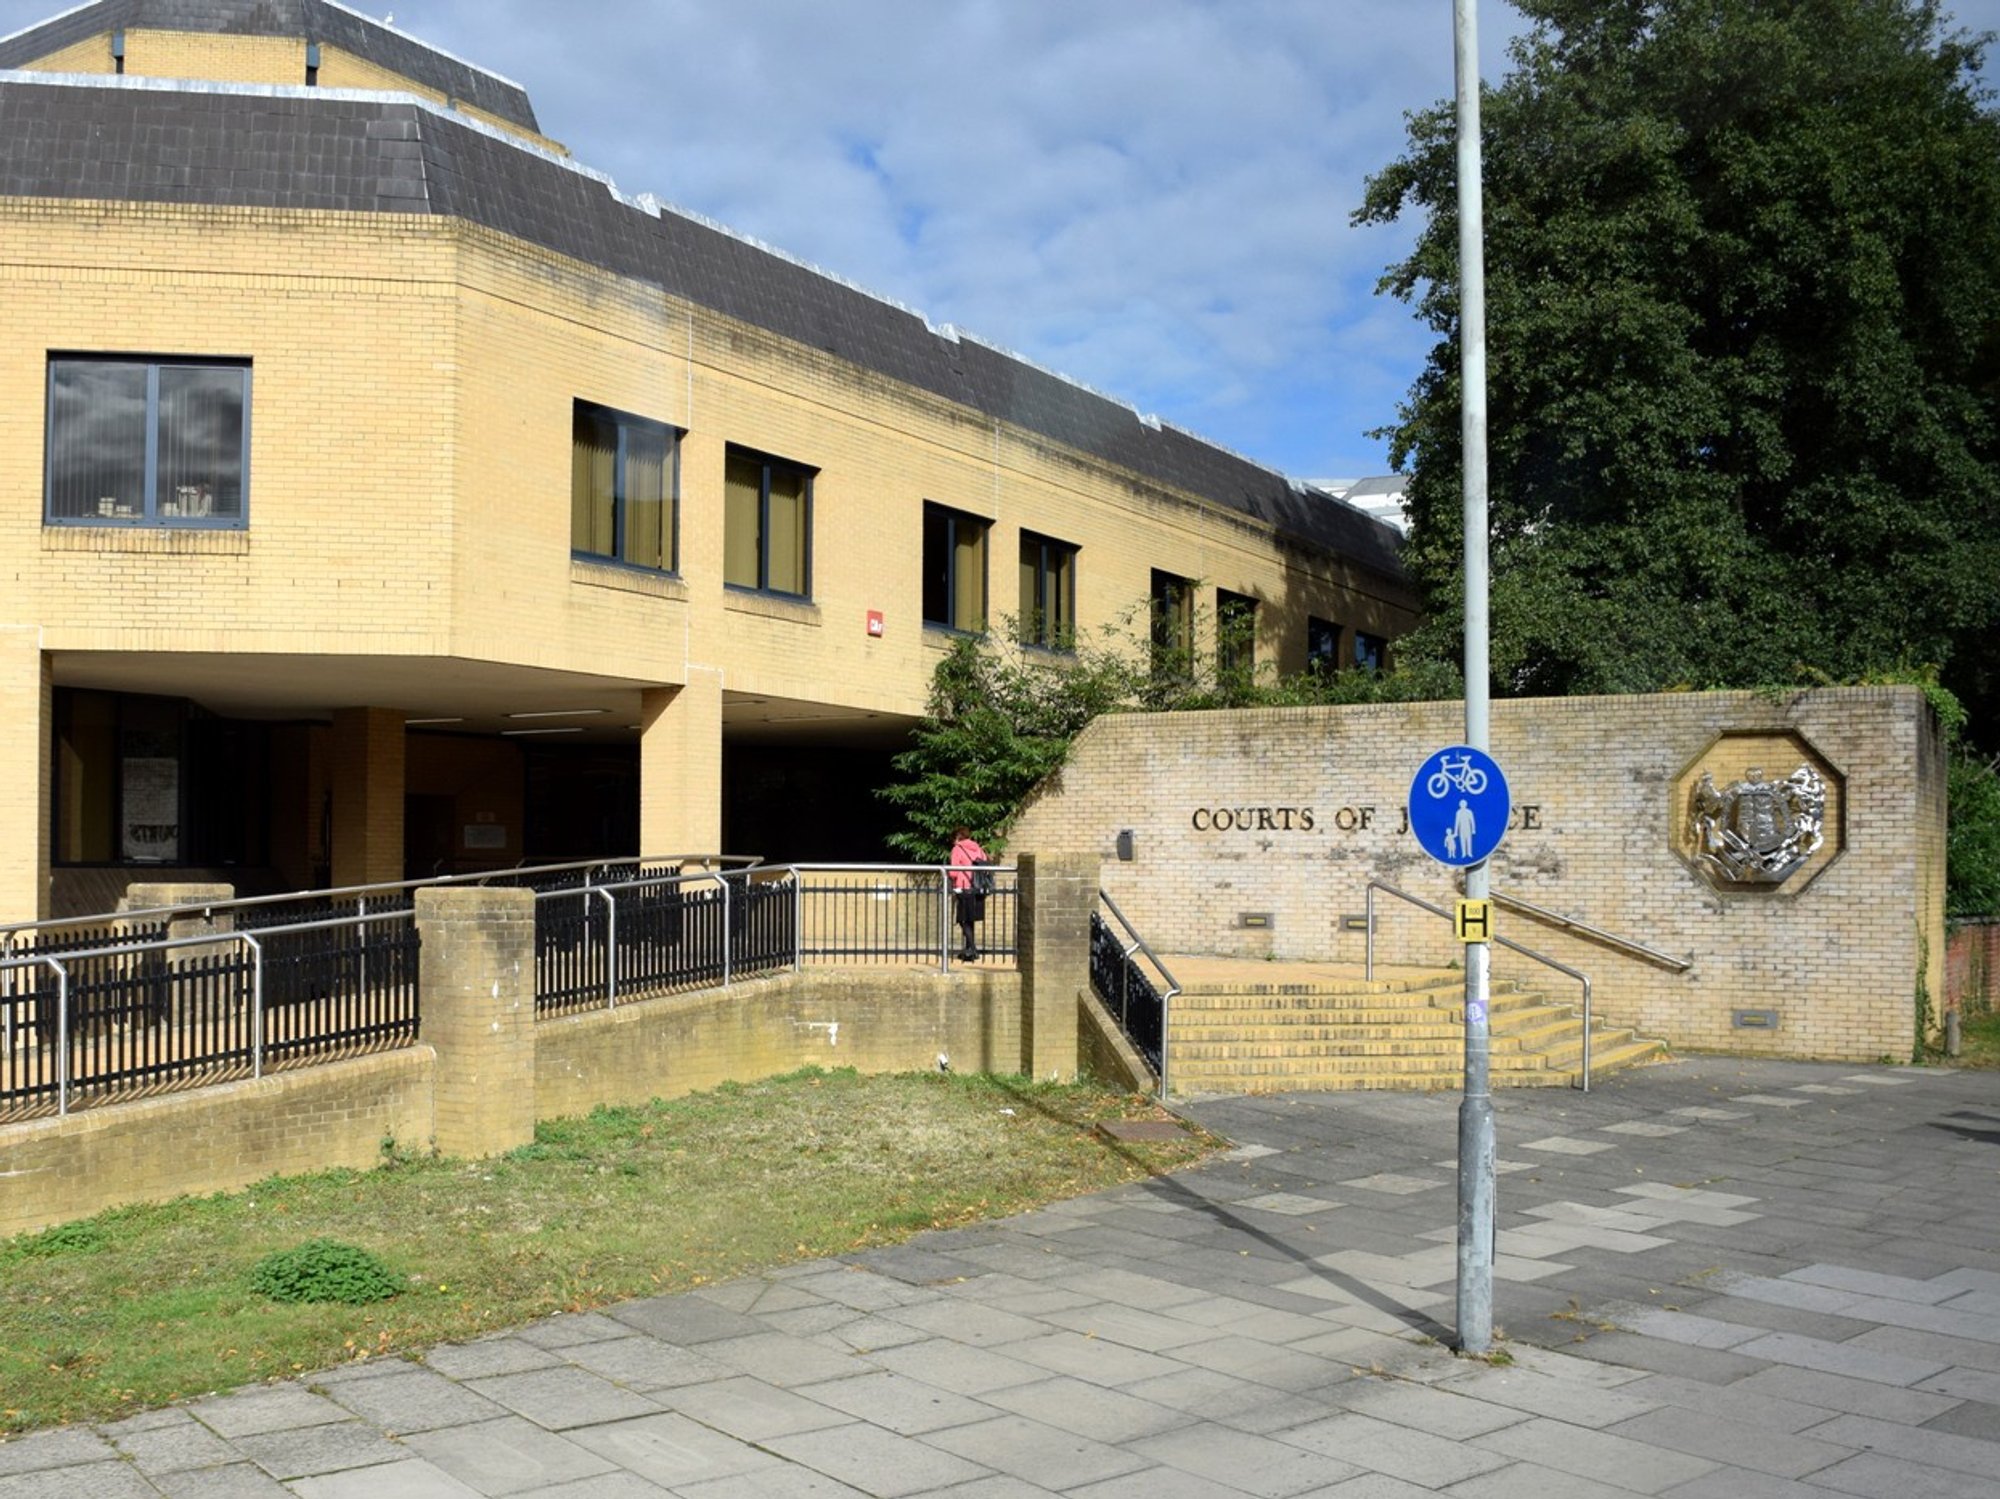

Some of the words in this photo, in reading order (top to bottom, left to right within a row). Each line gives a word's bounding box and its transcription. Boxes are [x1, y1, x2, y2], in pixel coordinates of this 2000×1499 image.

[1192, 806, 1315, 832] COURTS
[1334, 806, 1376, 832] OF
[1461, 904, 1487, 938] H
